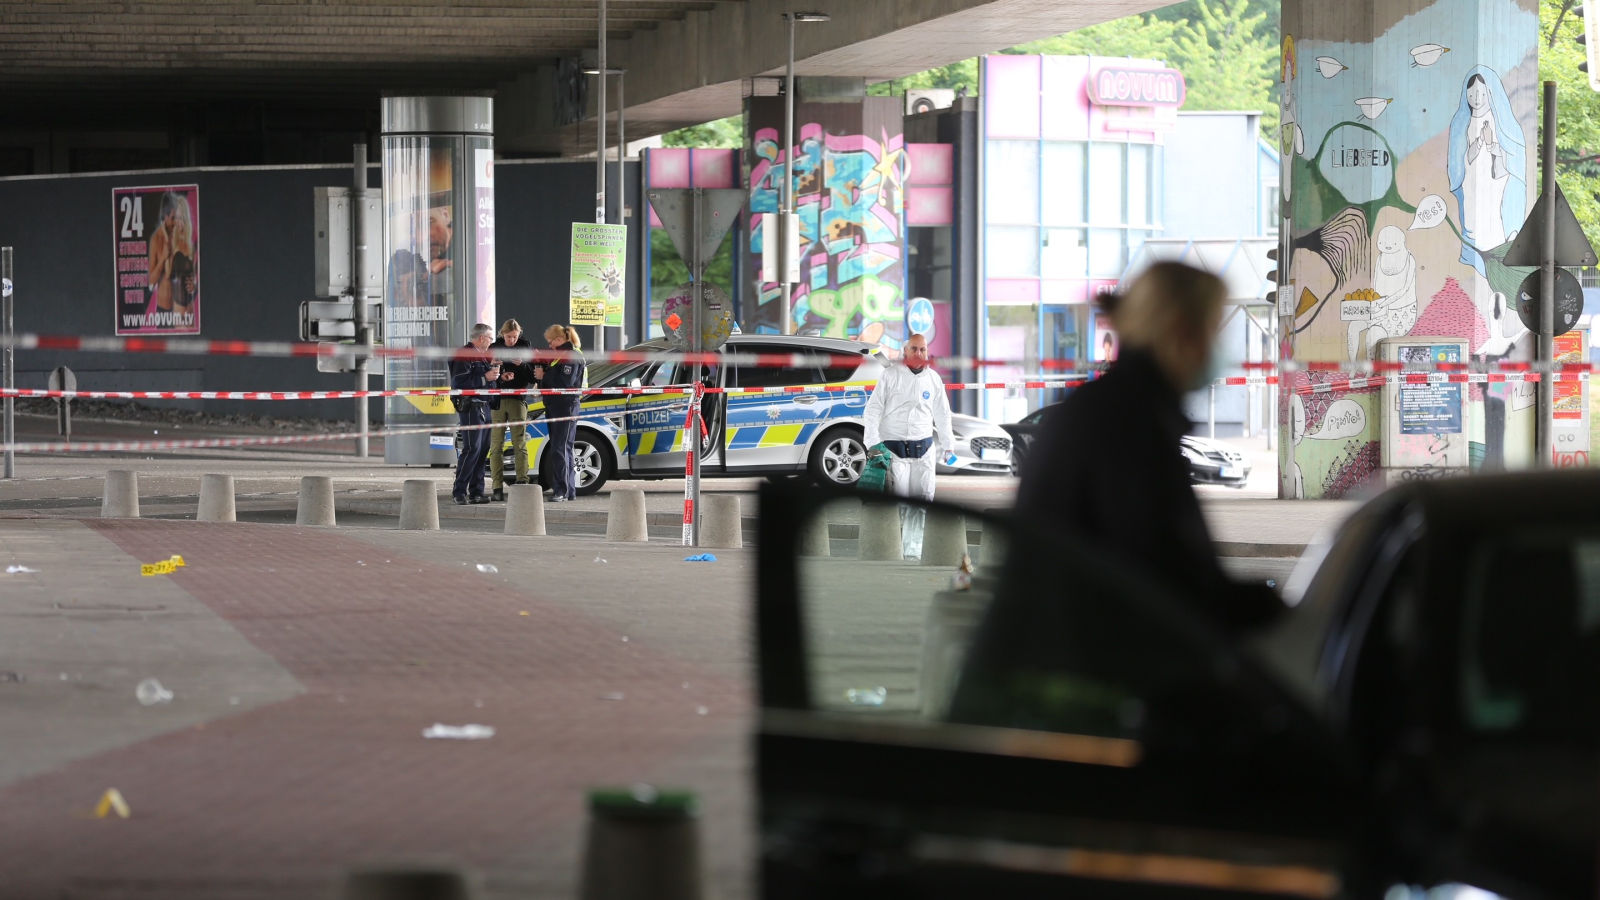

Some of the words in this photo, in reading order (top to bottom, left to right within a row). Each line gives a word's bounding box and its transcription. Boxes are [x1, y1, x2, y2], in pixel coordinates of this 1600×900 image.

[120, 196, 144, 238] 24
[575, 233, 624, 241] VOGELSPINNEN
[119, 241, 147, 255] STUNDEN
[120, 273, 149, 288] SHOPPEN
[124, 289, 145, 304] UNTER
[122, 310, 195, 327] www.novum.tv
[393, 305, 449, 321] ERFOLGREICHERE
[571, 313, 604, 322] Sonntag
[631, 410, 670, 426] POLIZEI
[142, 566, 154, 574] 32
